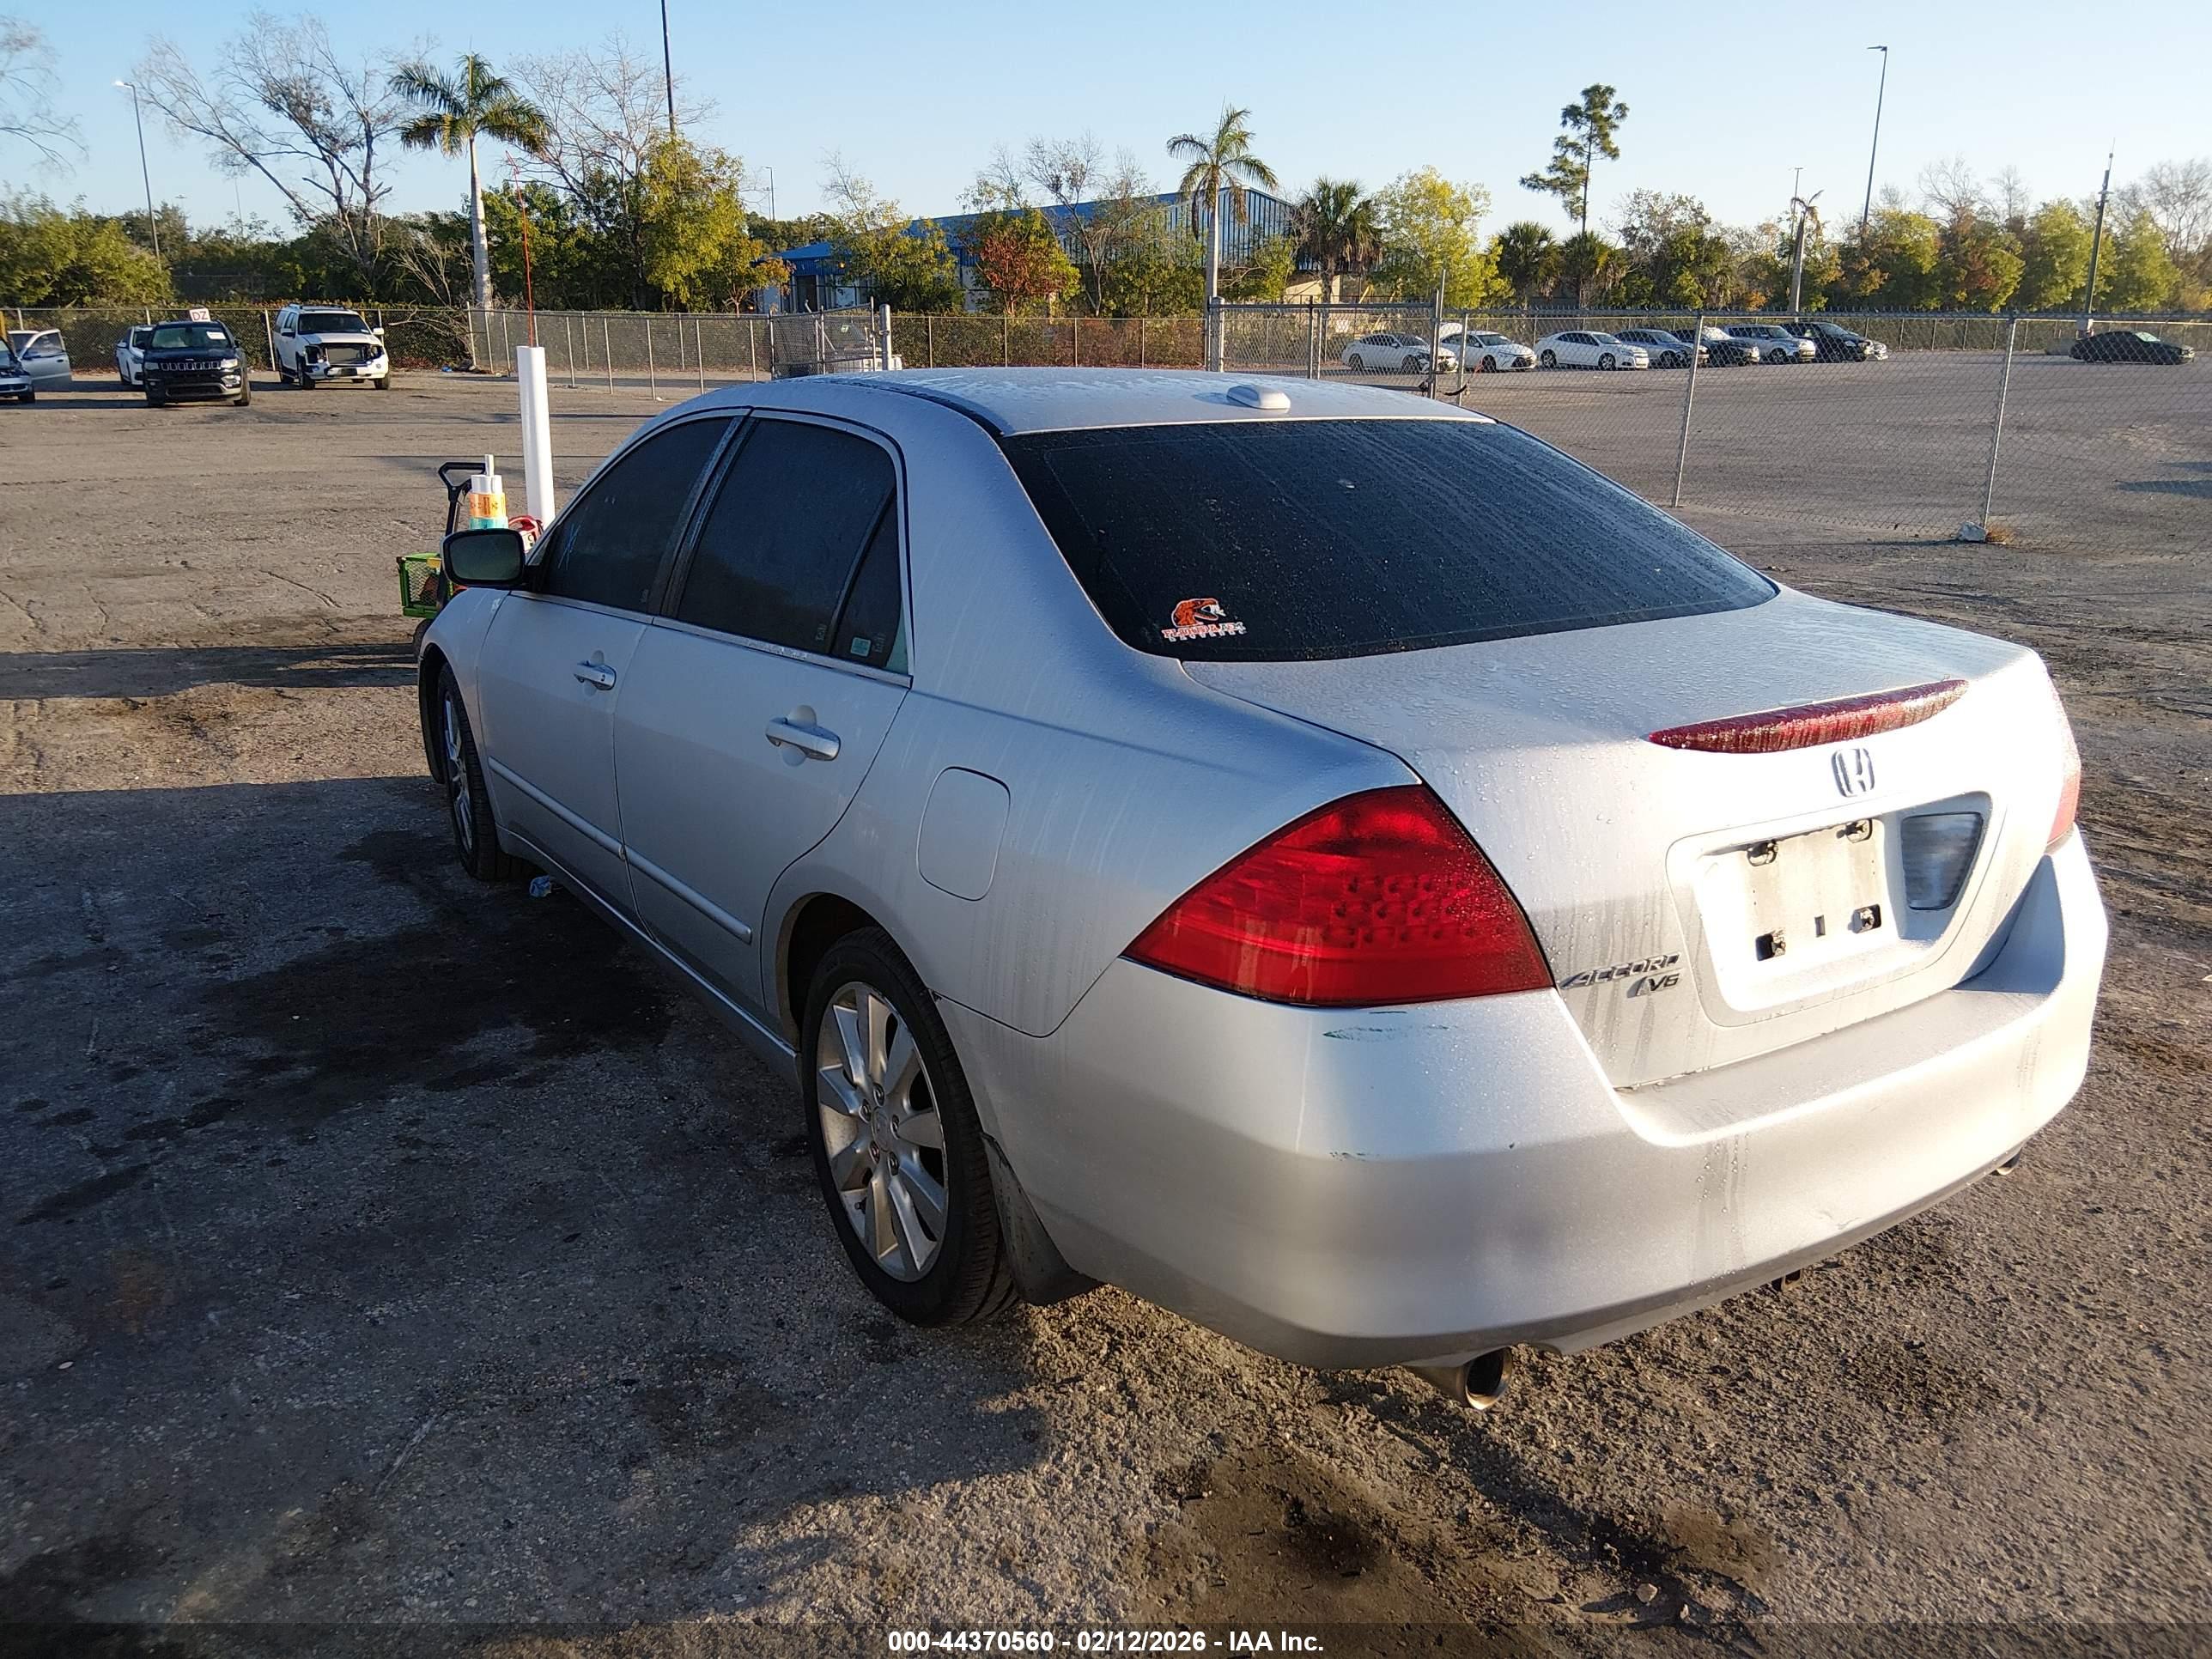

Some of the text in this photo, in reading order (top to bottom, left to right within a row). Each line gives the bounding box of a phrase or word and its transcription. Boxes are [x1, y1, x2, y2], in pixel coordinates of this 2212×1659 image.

[191, 310, 209, 321] DZ
[1560, 951, 1681, 990] ACCORD
[1646, 971, 1680, 993] V6
